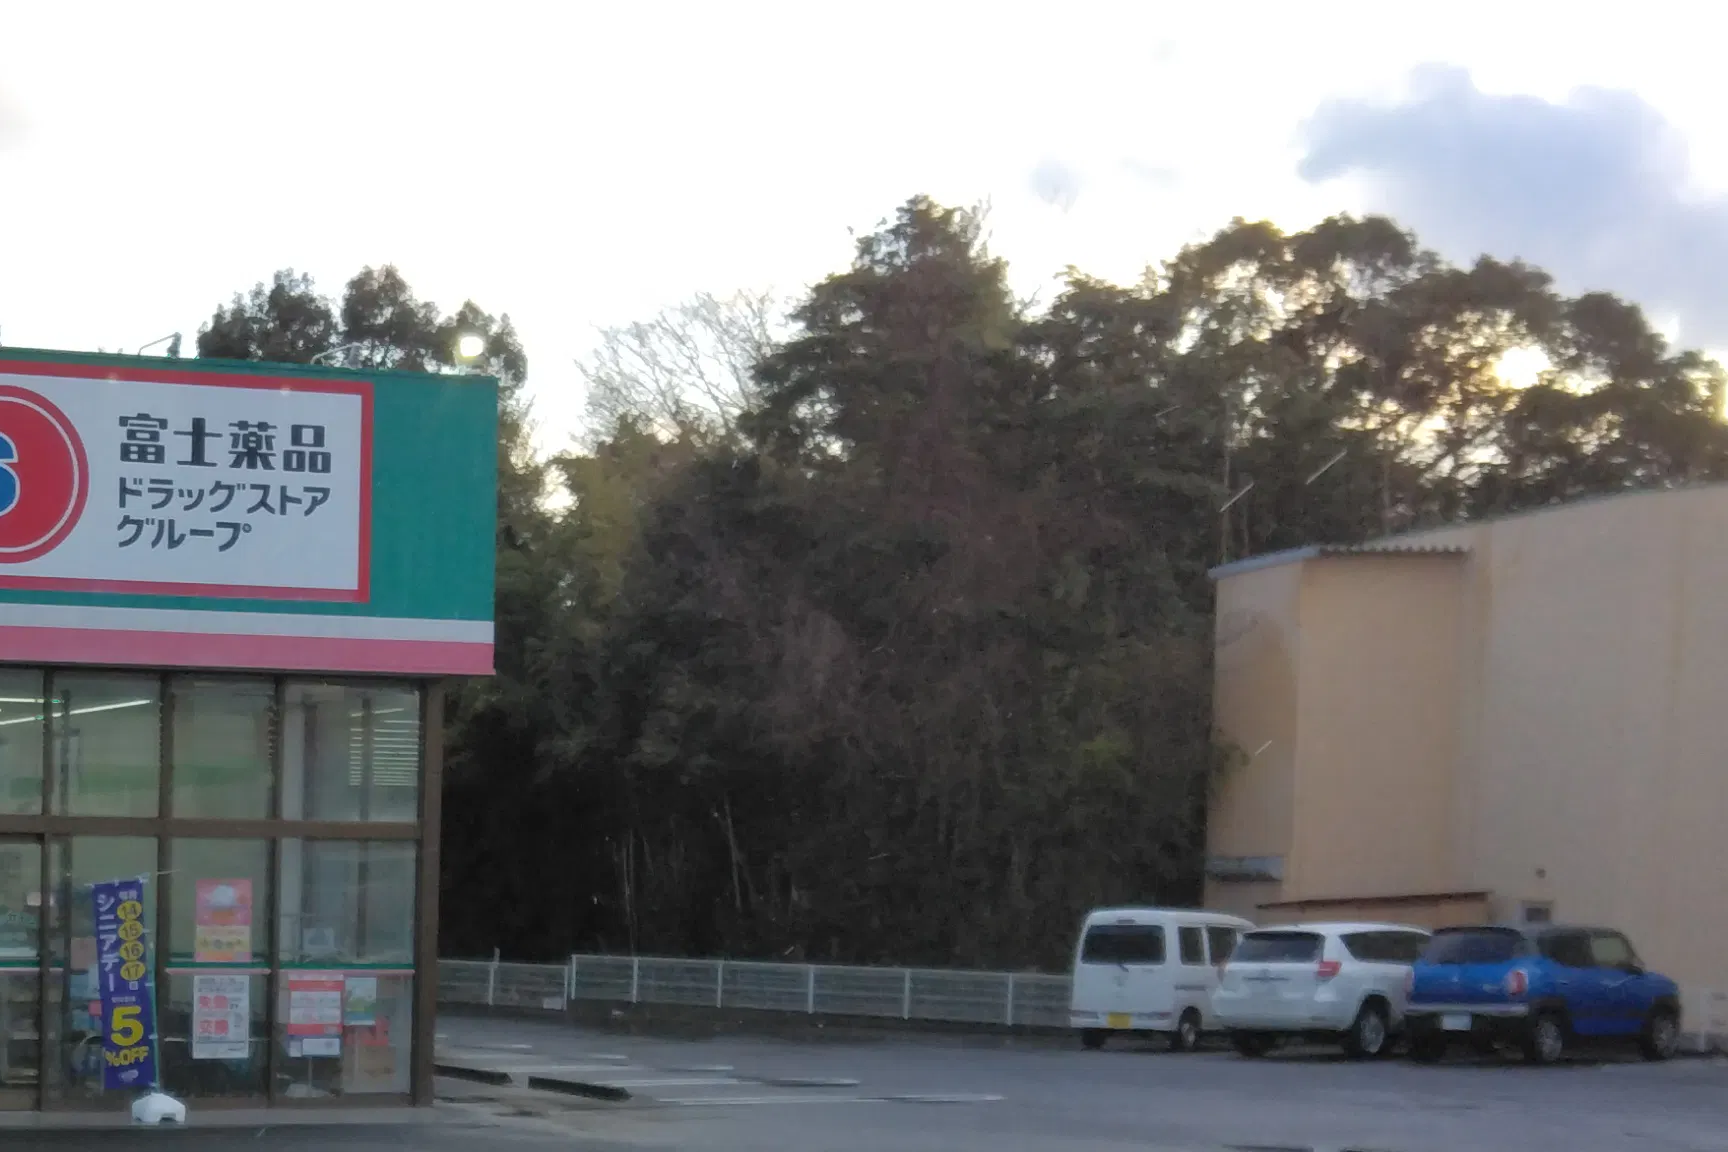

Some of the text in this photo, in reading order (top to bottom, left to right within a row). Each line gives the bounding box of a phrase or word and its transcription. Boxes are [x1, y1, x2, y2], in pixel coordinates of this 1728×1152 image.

[118, 413, 332, 474] 富士薬品
[118, 476, 331, 517] ドラッグストア
[117, 514, 253, 552] グループ
[96, 894, 121, 992] シニアデー
[110, 1005, 145, 1047] 5
